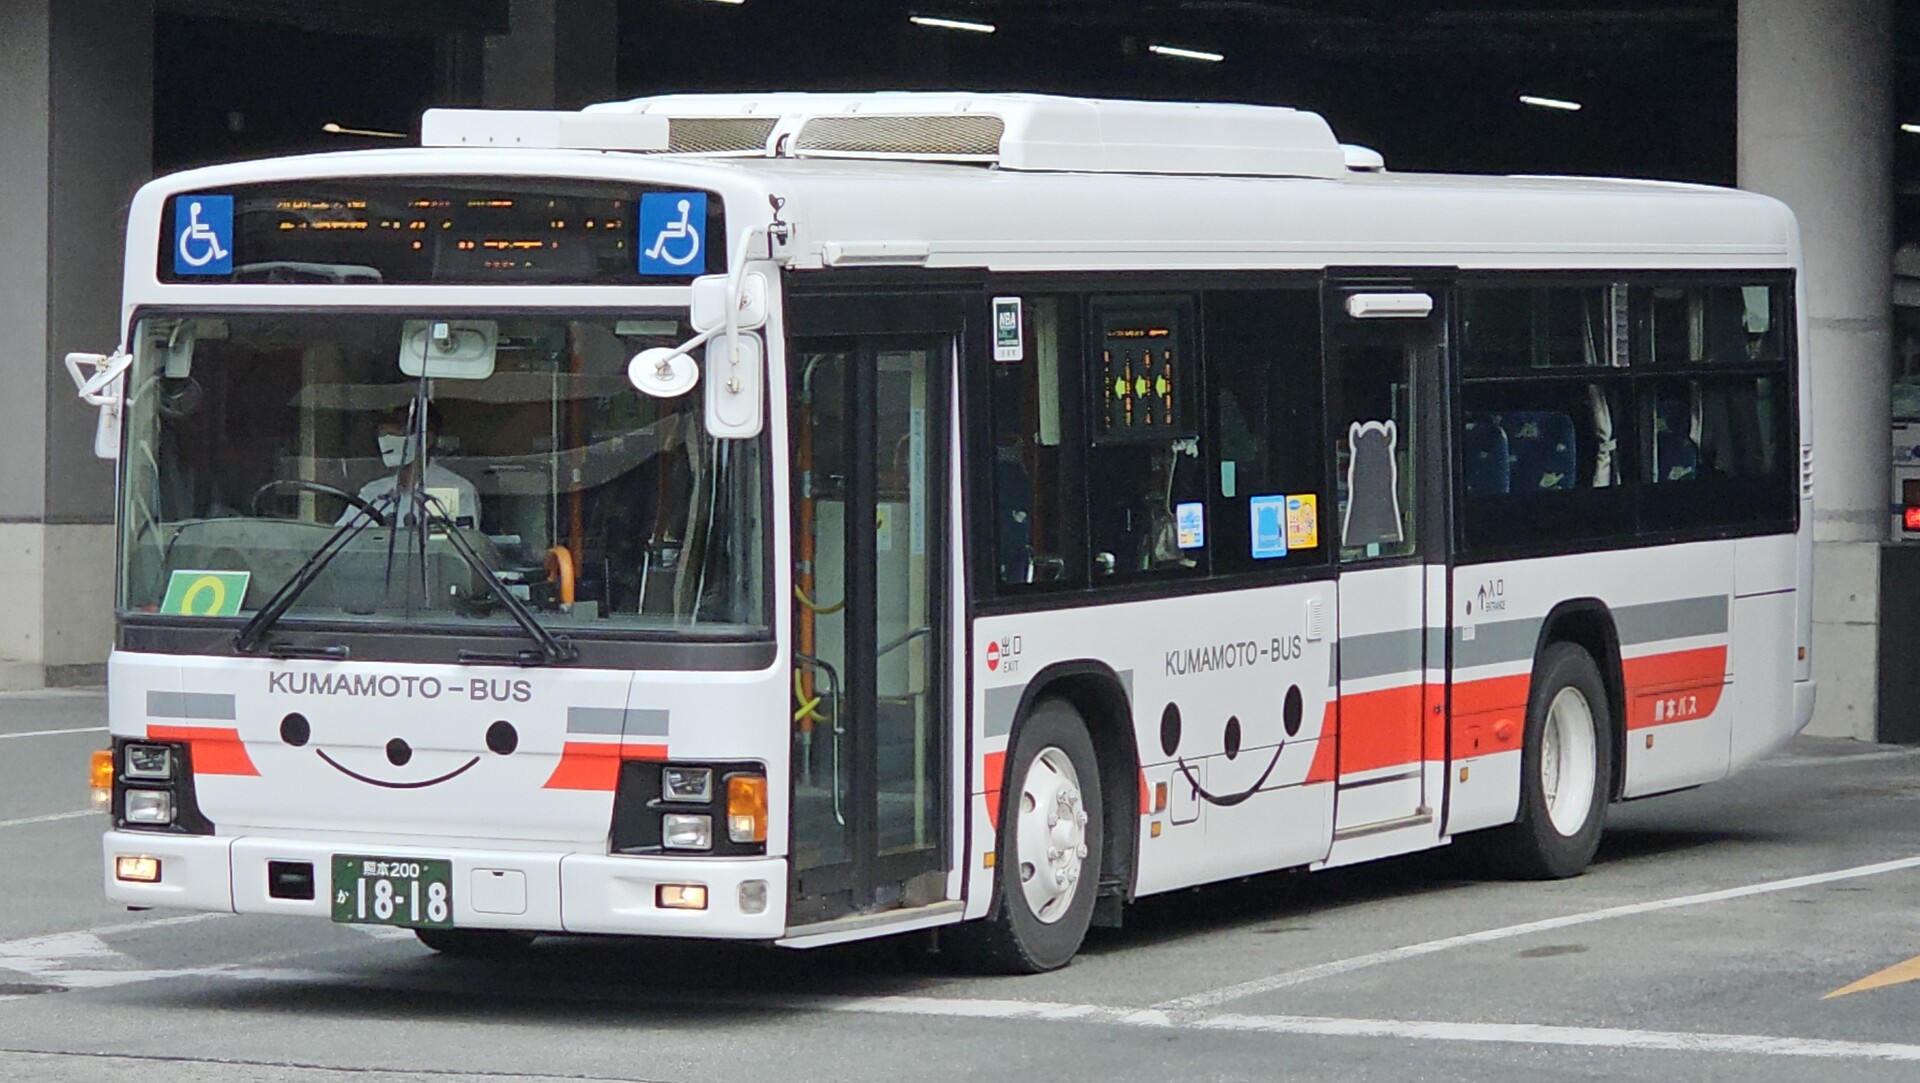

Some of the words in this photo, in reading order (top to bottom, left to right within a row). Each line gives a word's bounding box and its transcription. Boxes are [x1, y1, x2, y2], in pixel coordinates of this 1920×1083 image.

[1001, 635, 1022, 657] 出口
[1003, 660, 1019, 673] EXIT
[357, 878, 448, 922] 18-18
